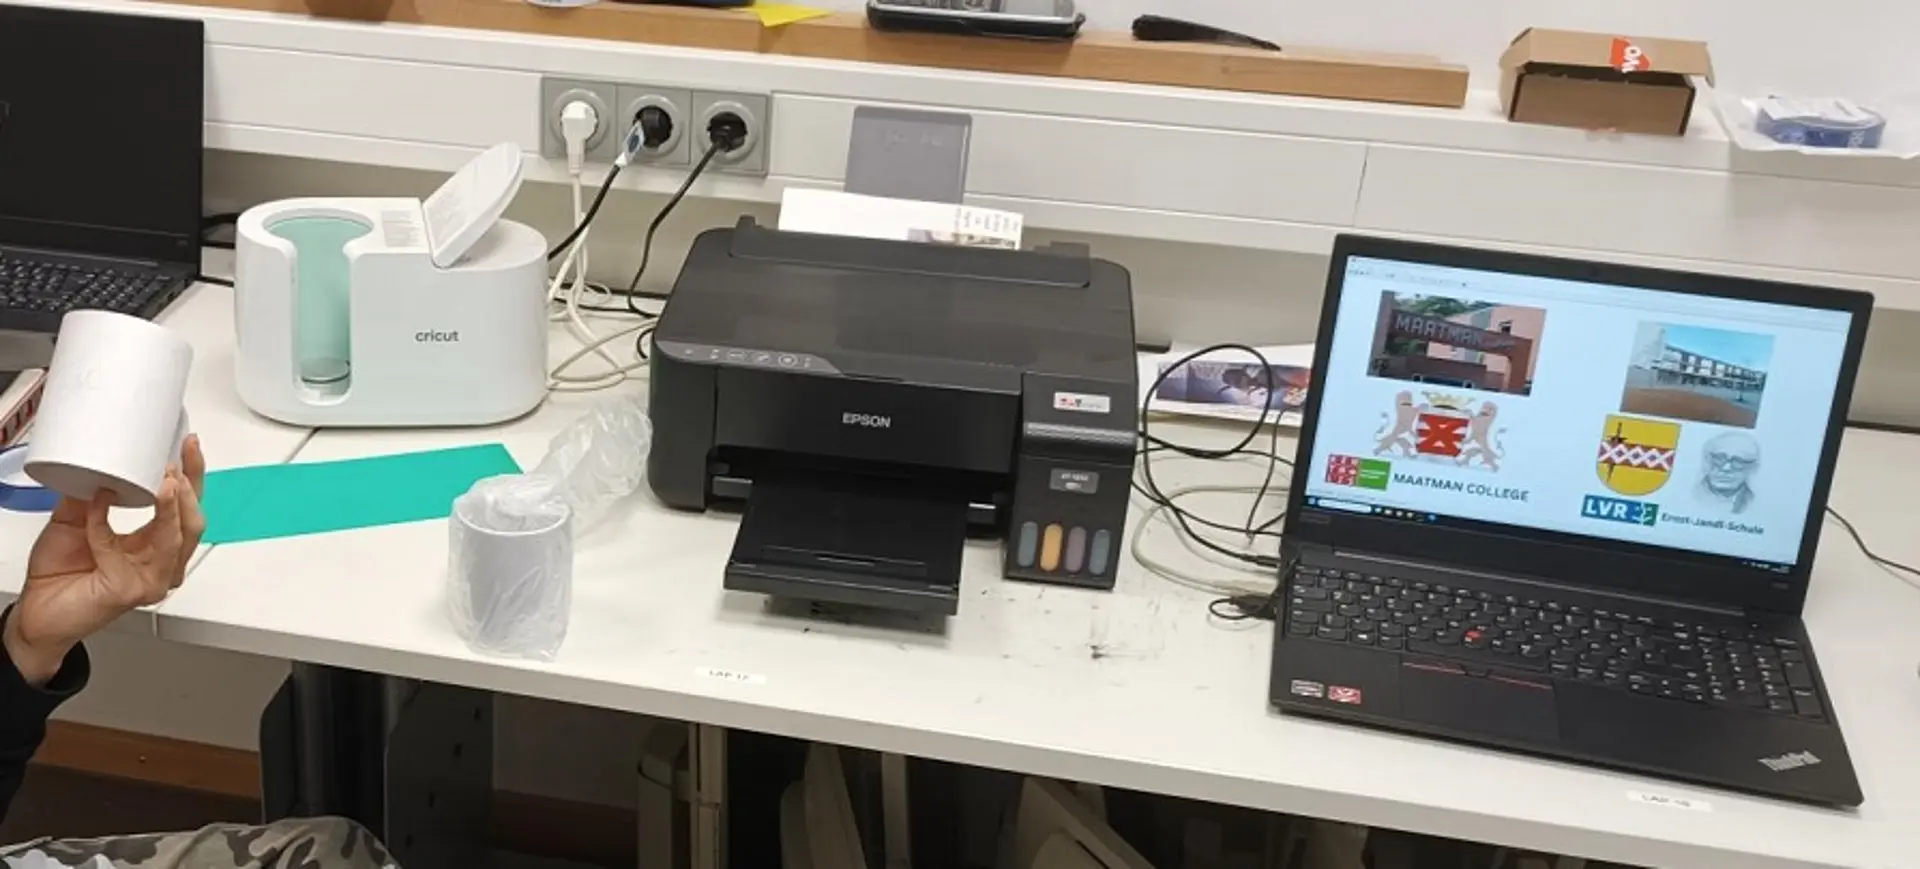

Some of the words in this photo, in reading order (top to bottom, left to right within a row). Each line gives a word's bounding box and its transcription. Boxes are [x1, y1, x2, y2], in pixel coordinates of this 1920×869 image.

[414, 328, 460, 342] cricut
[1395, 313, 1483, 345] MAATMAN
[842, 412, 891, 428] EPSON
[1393, 473, 1464, 492] MAATMAN
[1466, 483, 1530, 502] COLLEGE
[1585, 498, 1628, 519] LVR
